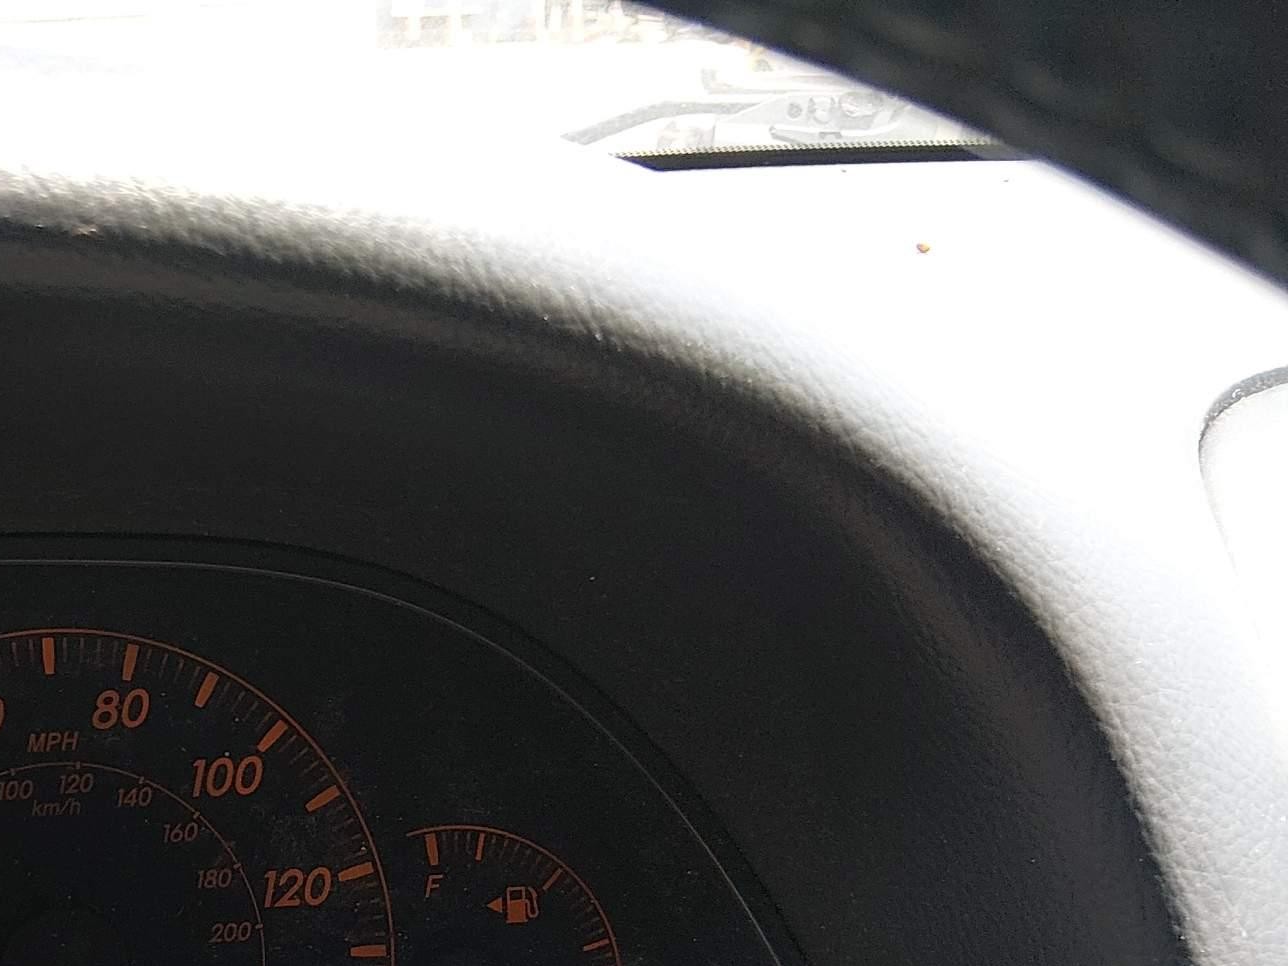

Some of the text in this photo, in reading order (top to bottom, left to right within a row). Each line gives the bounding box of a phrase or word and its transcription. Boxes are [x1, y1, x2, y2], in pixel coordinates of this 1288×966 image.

[93, 688, 151, 729] 80
[28, 731, 79, 753] MPH
[59, 773, 94, 794] 120
[192, 755, 263, 797] 100
[116, 786, 153, 806] 140
[32, 798, 80, 818] km/h
[163, 823, 199, 843] 160
[197, 869, 233, 889] 180
[265, 866, 333, 908] 120
[424, 873, 447, 898] F
[212, 922, 251, 942] 200
